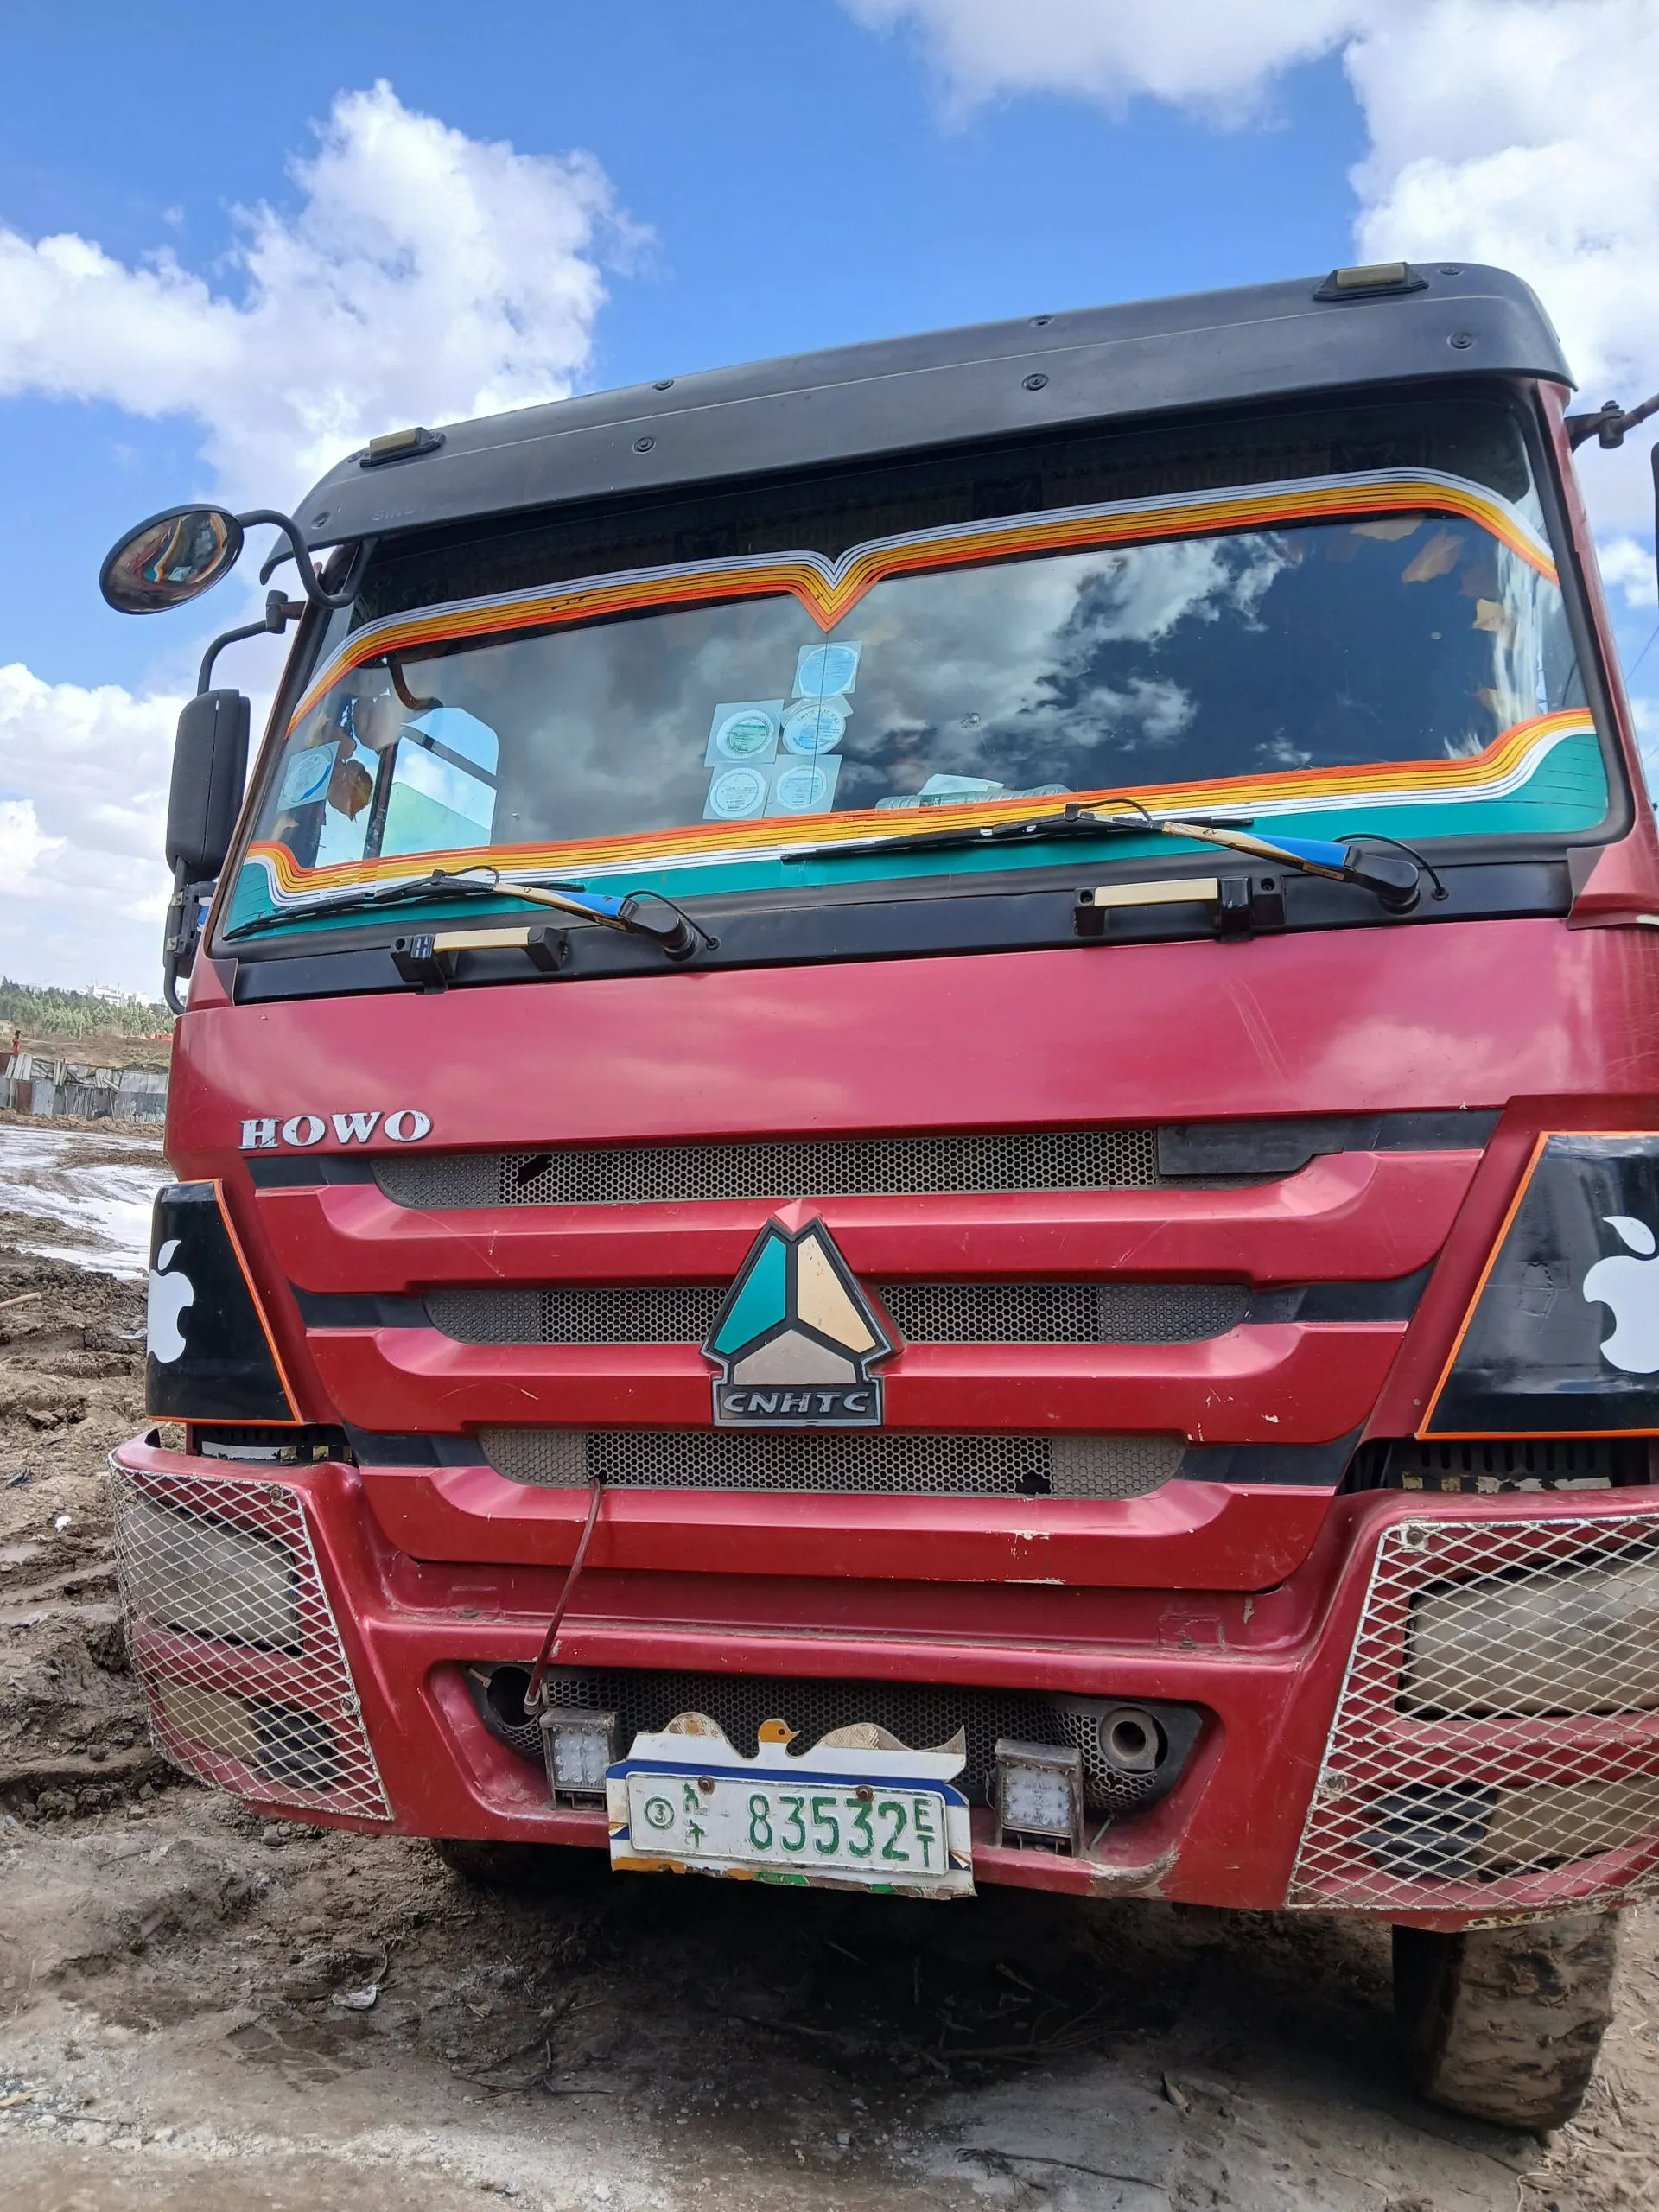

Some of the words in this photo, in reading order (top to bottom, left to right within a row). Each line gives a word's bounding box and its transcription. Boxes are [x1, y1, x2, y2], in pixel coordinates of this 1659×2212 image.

[238, 1109, 431, 1150] HOWO
[723, 1392, 869, 1414] CNHTC
[749, 1794, 910, 1861] 83532
[914, 1797, 936, 1867] ET
